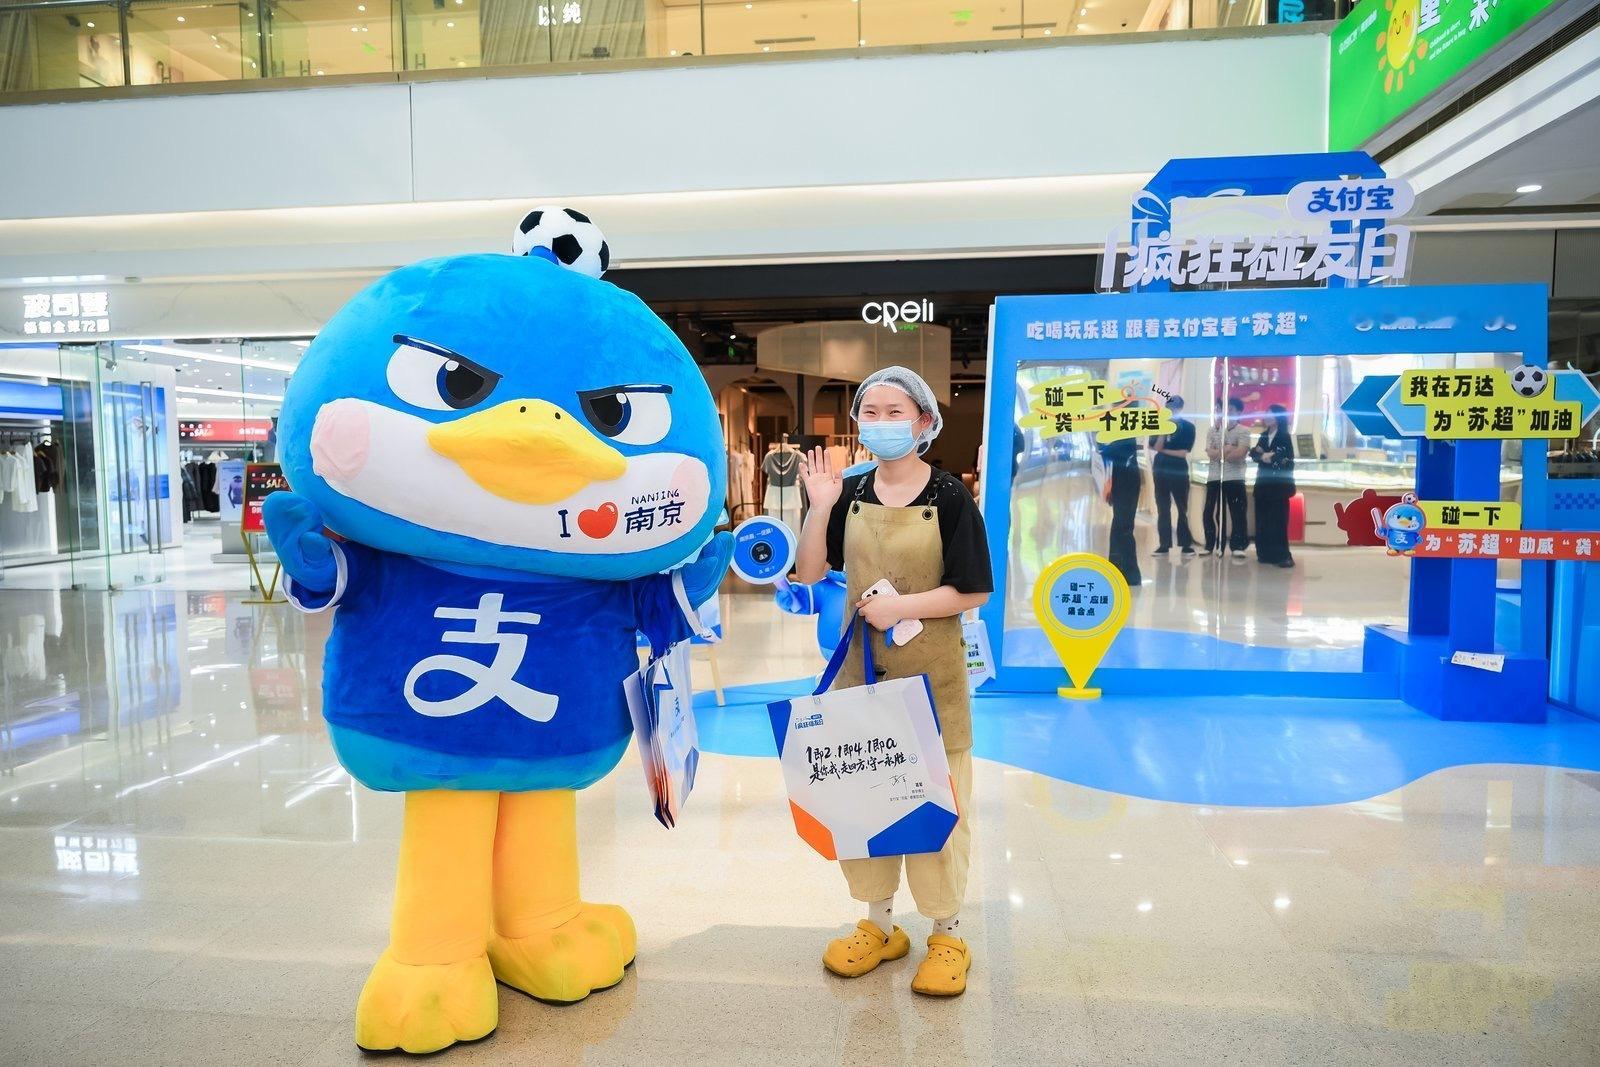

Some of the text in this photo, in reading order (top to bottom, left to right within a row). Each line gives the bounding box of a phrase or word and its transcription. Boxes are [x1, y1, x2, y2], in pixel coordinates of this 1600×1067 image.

[538, 2, 582, 26] 以纯
[1307, 185, 1394, 213] 支付宝
[1123, 225, 1411, 288] 疯狂碰友日
[1026, 311, 1308, 340] 吃喝玩乐逛 跟着支付宝看“苏超”
[1045, 385, 1105, 407] 碰一下
[1151, 384, 1174, 403] Lucky
[1410, 375, 1494, 398] 我在万达
[1433, 406, 1573, 432] 为“苏超”加油
[631, 489, 679, 504] NANJING
[558, 509, 571, 538] I
[624, 500, 685, 534] 南京
[1442, 506, 1501, 526] 碰一下
[1070, 582, 1095, 592] 碰一下
[404, 593, 559, 722] 支
